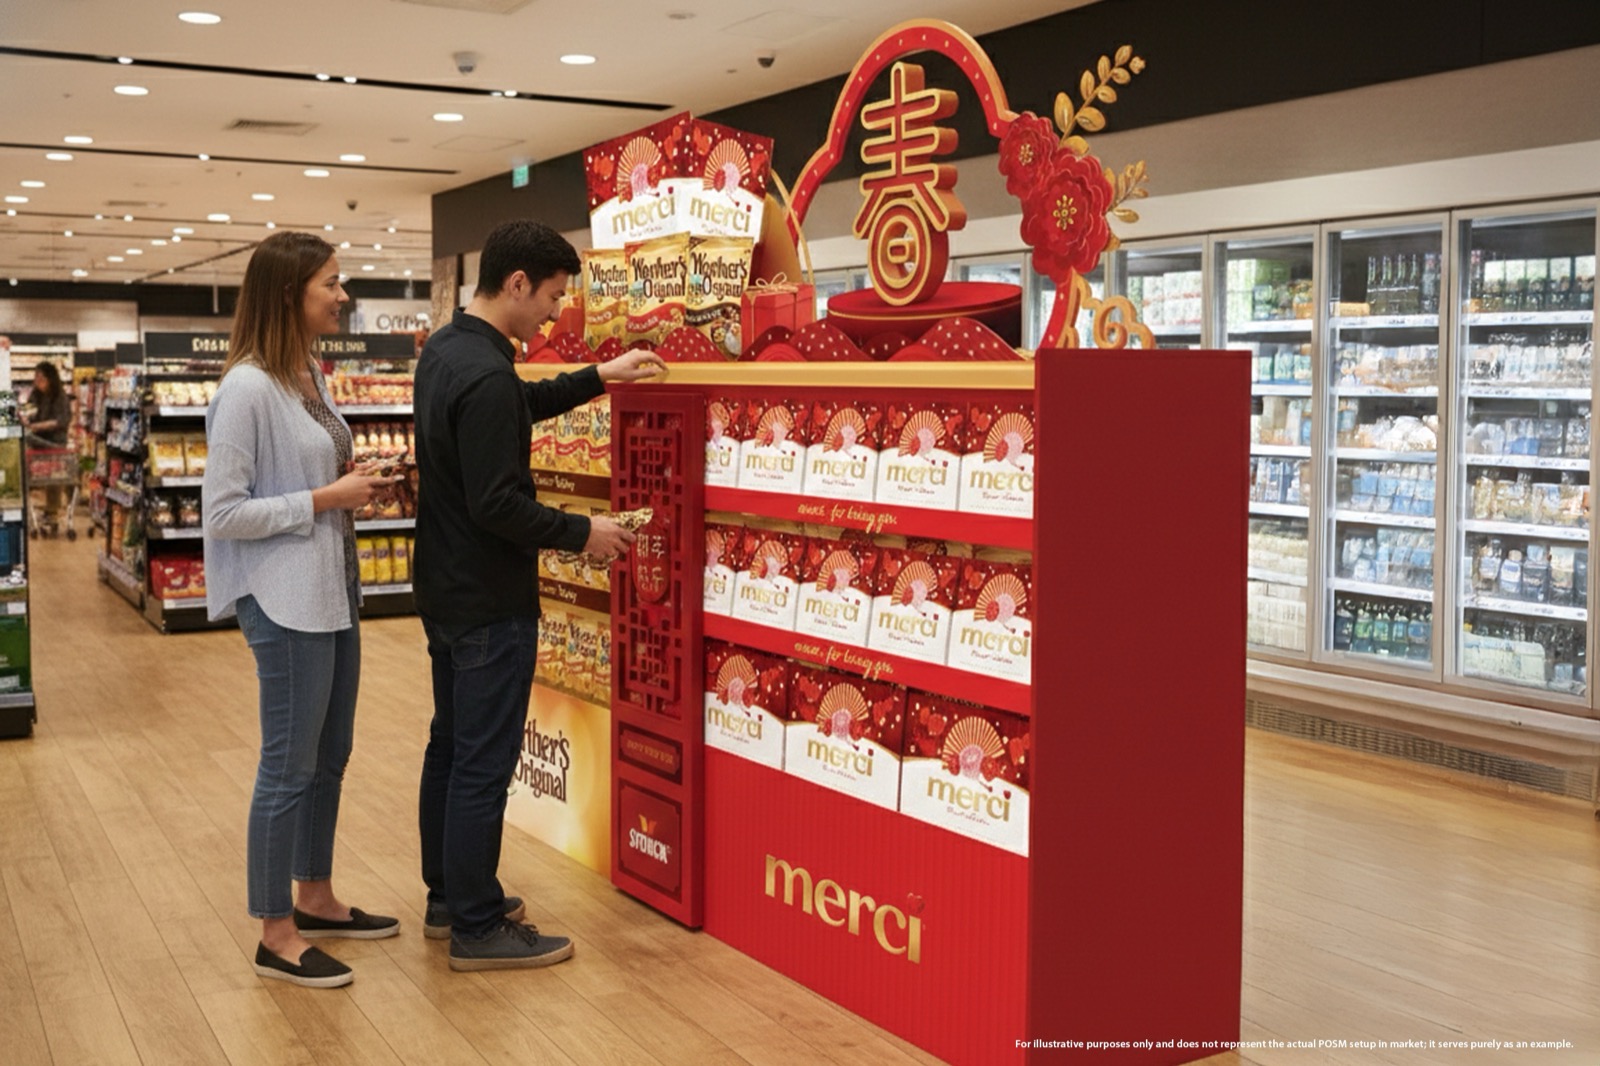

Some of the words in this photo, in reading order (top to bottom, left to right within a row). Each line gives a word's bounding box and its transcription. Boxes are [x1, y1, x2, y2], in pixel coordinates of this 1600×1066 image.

[853, 62, 966, 306] 春
[612, 187, 677, 235] merci
[689, 196, 751, 233] merci
[812, 456, 866, 479] merci
[886, 461, 947, 486] merci
[970, 470, 1033, 492] merc
[805, 594, 860, 623] merci
[878, 610, 939, 638] merci
[960, 625, 1030, 658] merci
[708, 706, 763, 741] merci
[807, 737, 874, 777] merci
[927, 775, 1011, 822] merci
[765, 854, 923, 964] merci
